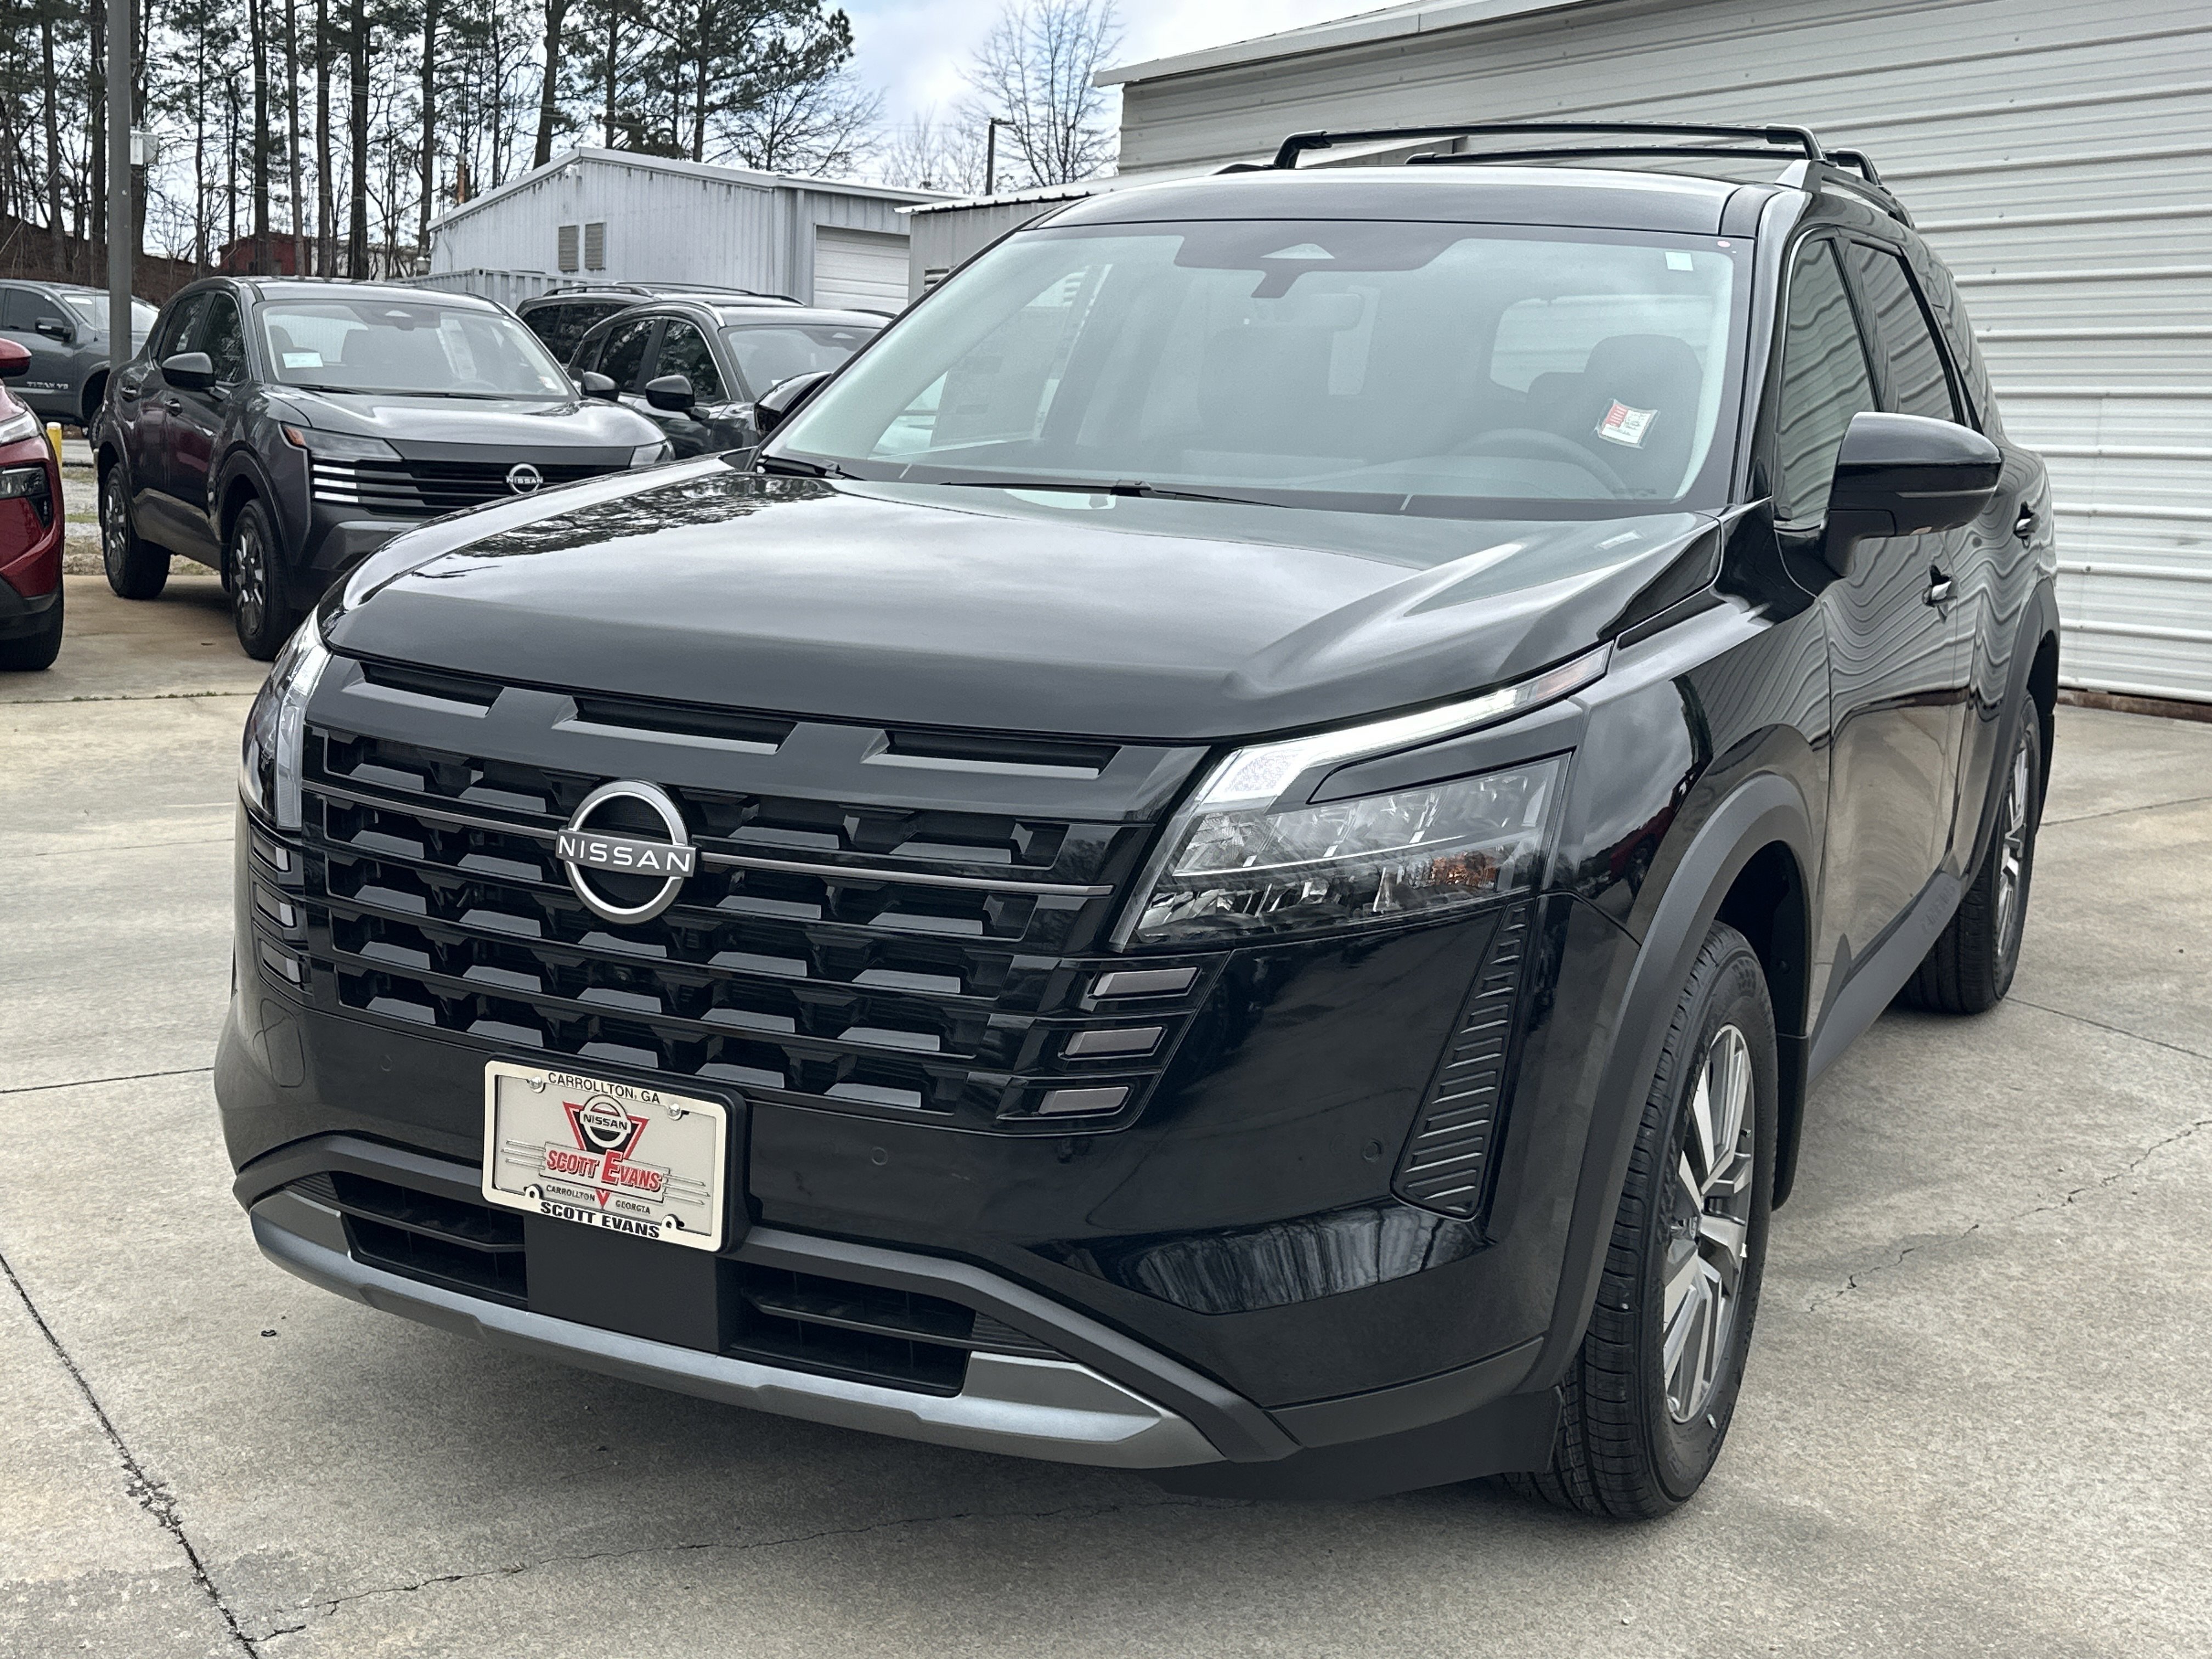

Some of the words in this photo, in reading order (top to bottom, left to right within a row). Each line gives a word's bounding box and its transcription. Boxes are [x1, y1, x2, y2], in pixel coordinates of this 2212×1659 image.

[558, 836, 690, 872] NISSAN
[549, 1073, 637, 1099] CARROLLTON,
[641, 1090, 661, 1104] GA
[583, 1114, 628, 1130] NISSAN
[547, 1150, 600, 1178] SCOTT
[601, 1149, 662, 1192] EVANS
[546, 1185, 595, 1201] CARROLLTON
[616, 1200, 650, 1214] GEORGIA
[540, 1202, 596, 1223] SCOTT
[602, 1216, 660, 1238] EVANS
